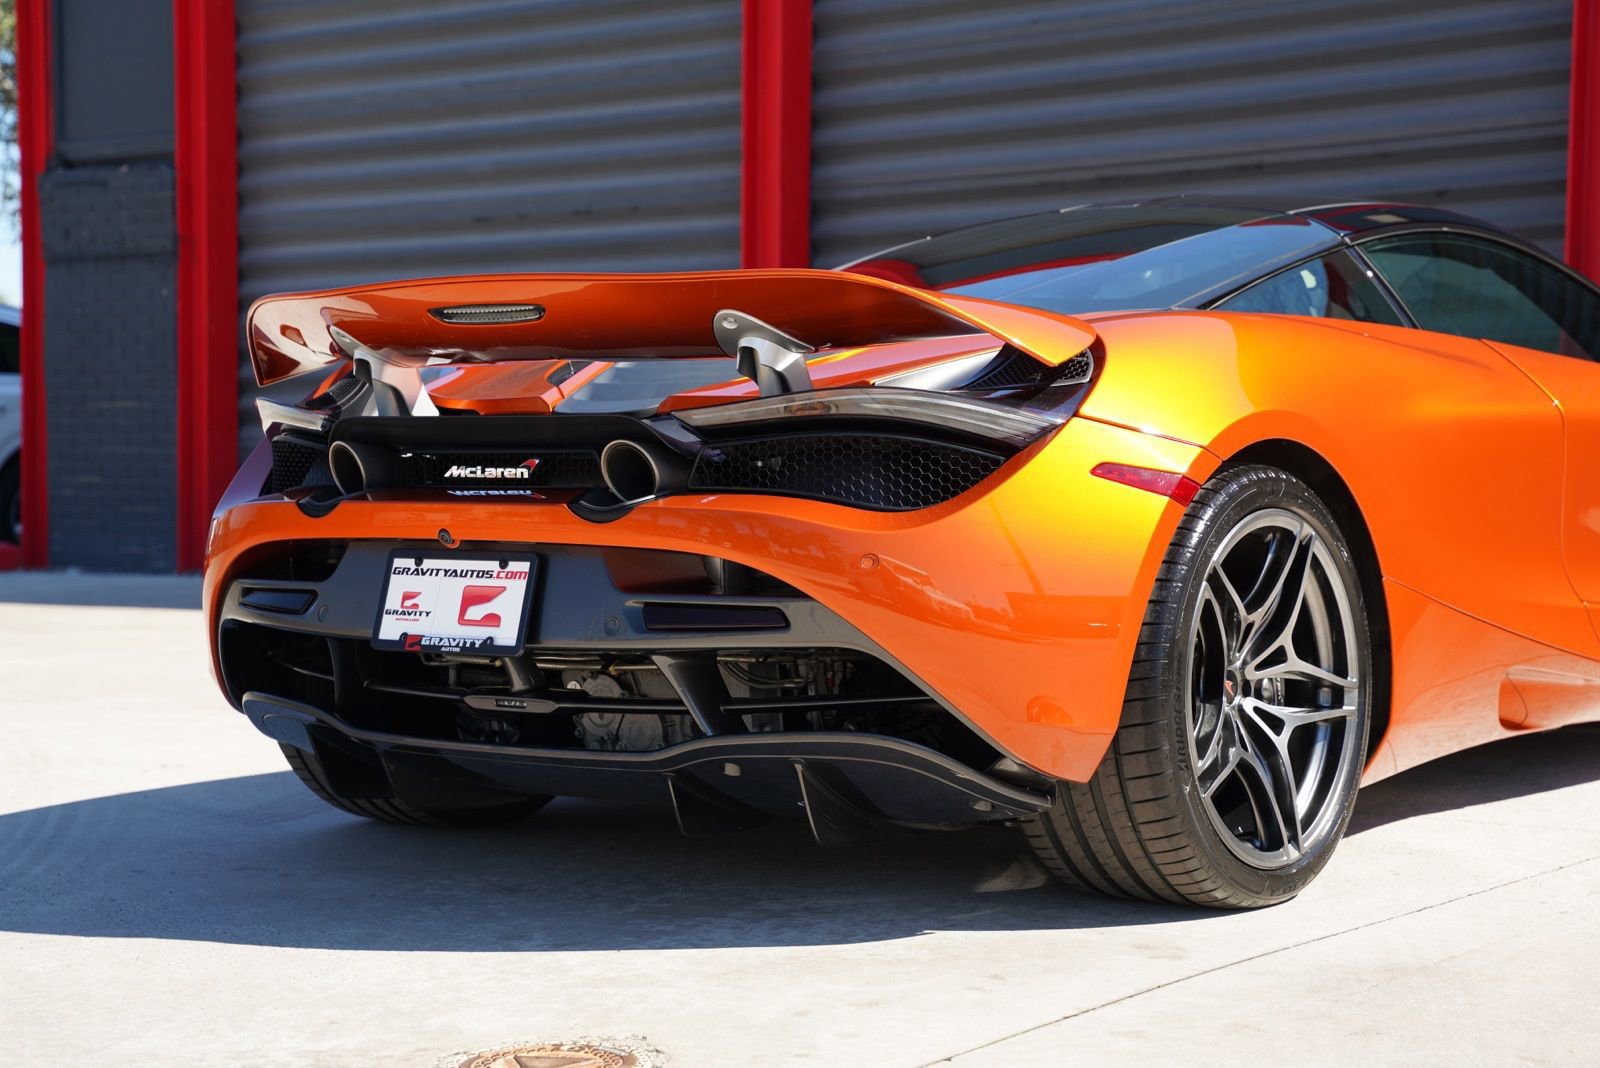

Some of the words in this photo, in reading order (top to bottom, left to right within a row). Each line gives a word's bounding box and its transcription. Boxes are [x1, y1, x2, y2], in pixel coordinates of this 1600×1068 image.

[444, 465, 529, 479] McLaren
[392, 566, 529, 580] GRAVITYAUTOS.COM
[384, 608, 432, 618] GRAVITY
[421, 636, 484, 648] GRAVITY
